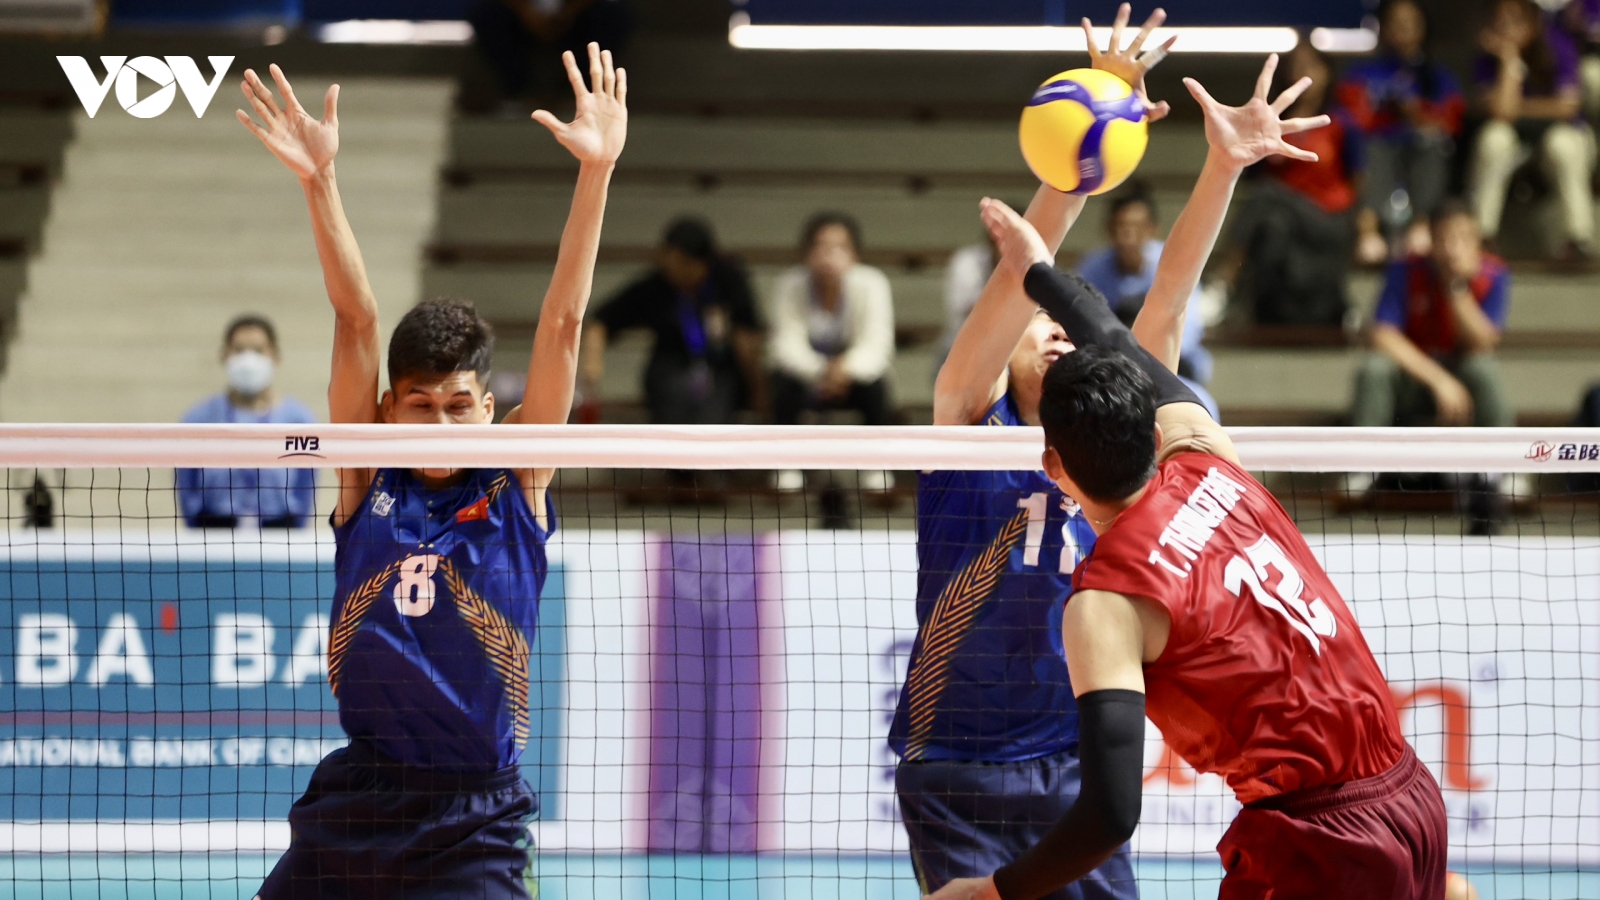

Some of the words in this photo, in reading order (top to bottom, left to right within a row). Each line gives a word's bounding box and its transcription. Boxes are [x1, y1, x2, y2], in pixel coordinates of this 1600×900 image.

[285, 436, 320, 450] FIVB
[393, 554, 438, 617] 8
[1224, 533, 1337, 657] 12
